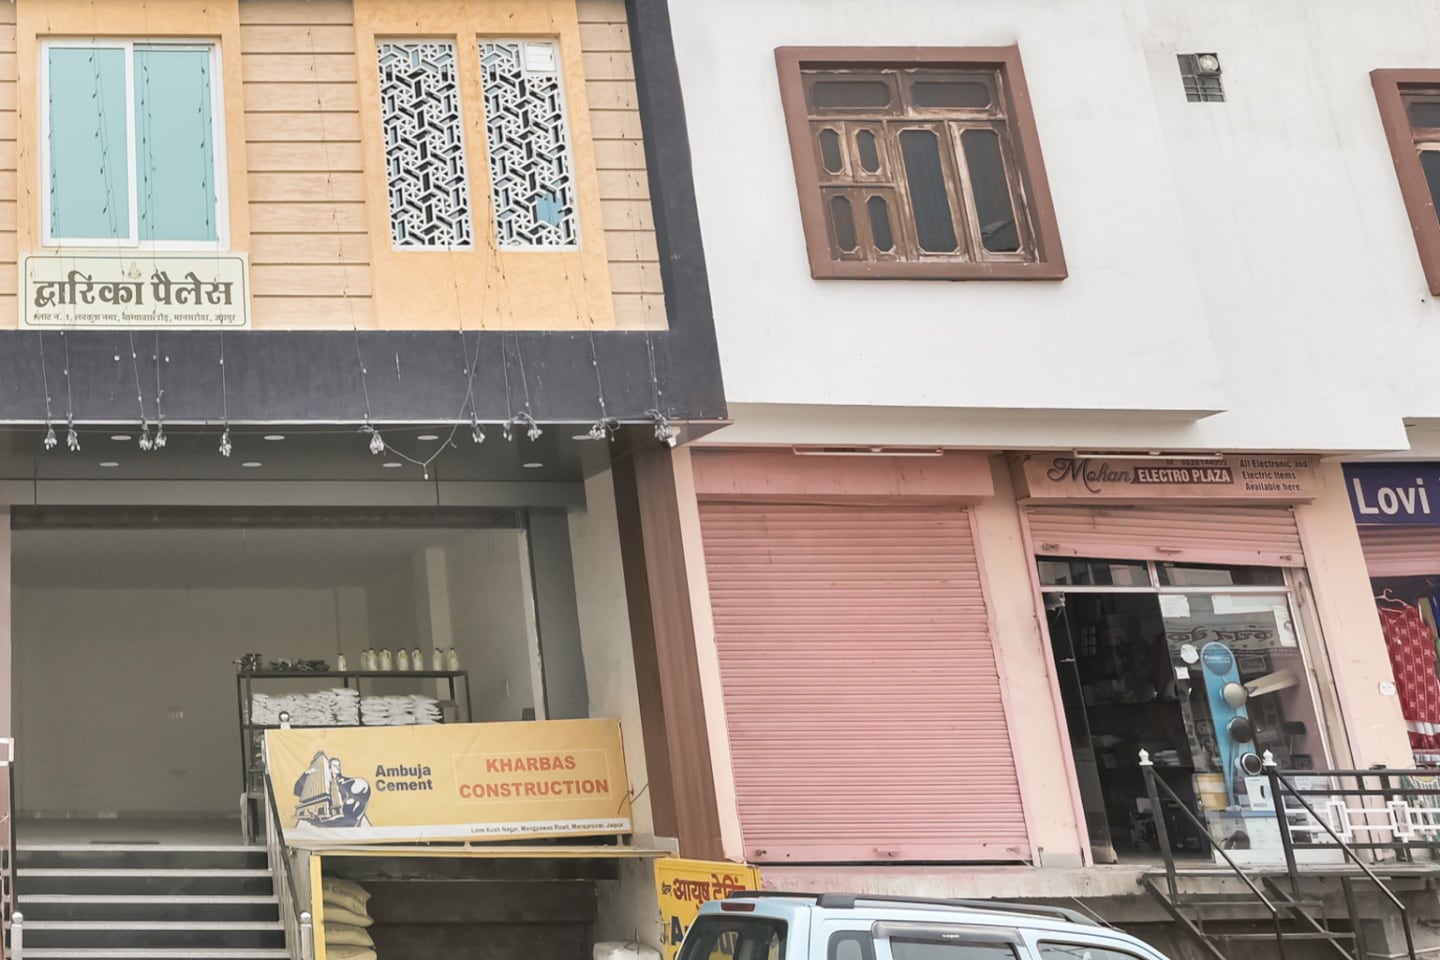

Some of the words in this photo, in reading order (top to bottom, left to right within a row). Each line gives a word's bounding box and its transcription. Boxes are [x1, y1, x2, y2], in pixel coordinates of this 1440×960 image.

[33, 270, 144, 307] द्वारिका
[150, 271, 234, 305] पैलेस
[1240, 460, 1250, 468] All
[1252, 460, 1292, 468] Electronic
[1295, 460, 1308, 468] and
[1046, 457, 1132, 493] Mohan
[1138, 469, 1190, 482] ELECTRO
[1192, 469, 1231, 483] PLAZA
[1242, 471, 1273, 480] Electric
[1274, 471, 1296, 480] Items
[1245, 482, 1281, 491] Available
[1353, 477, 1431, 515] Lovi
[375, 764, 432, 780] Ambuja
[486, 756, 576, 773] KHARBAS
[375, 779, 433, 792] Cement
[459, 779, 609, 798] CONSTRUCTION
